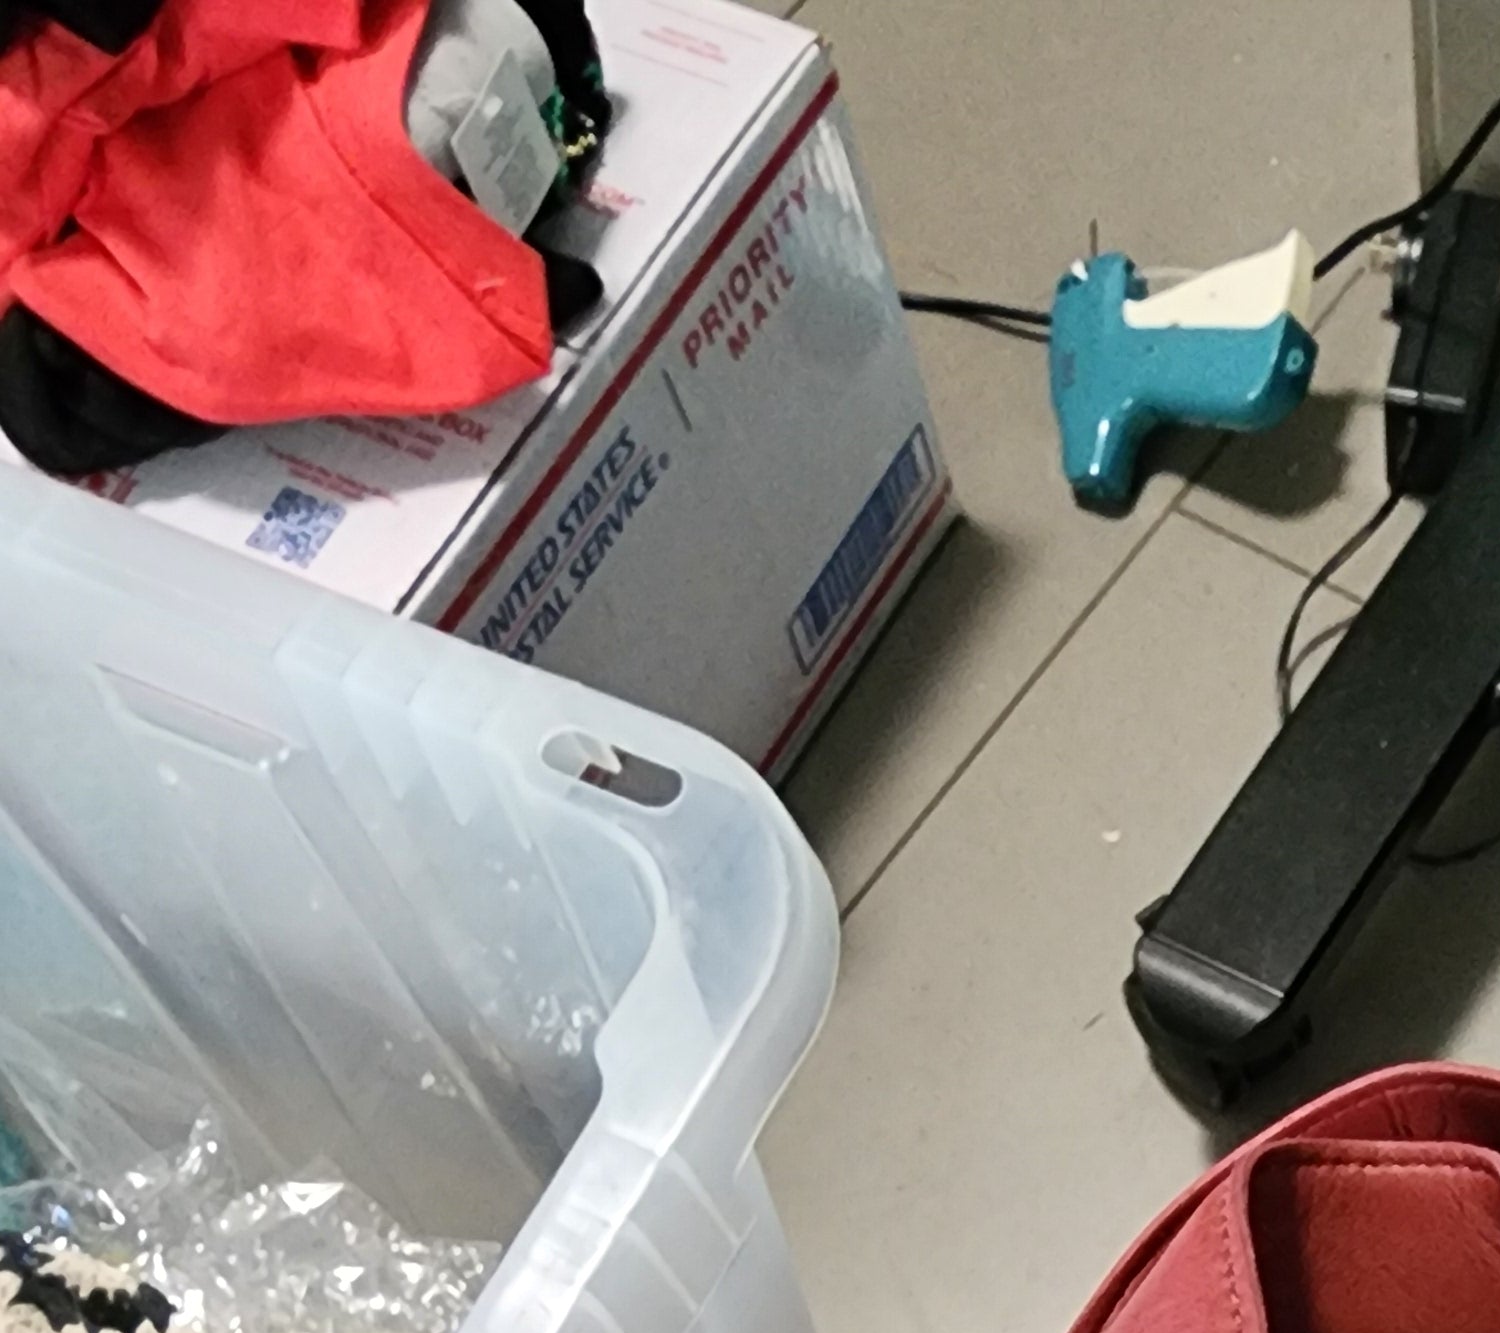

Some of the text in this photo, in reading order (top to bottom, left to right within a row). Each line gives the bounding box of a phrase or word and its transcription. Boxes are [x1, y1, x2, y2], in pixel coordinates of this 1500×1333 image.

[682, 174, 808, 369] PRIORITY
[726, 264, 795, 361] MAIL
[557, 424, 636, 549] STATES
[508, 586, 573, 664] STAL
